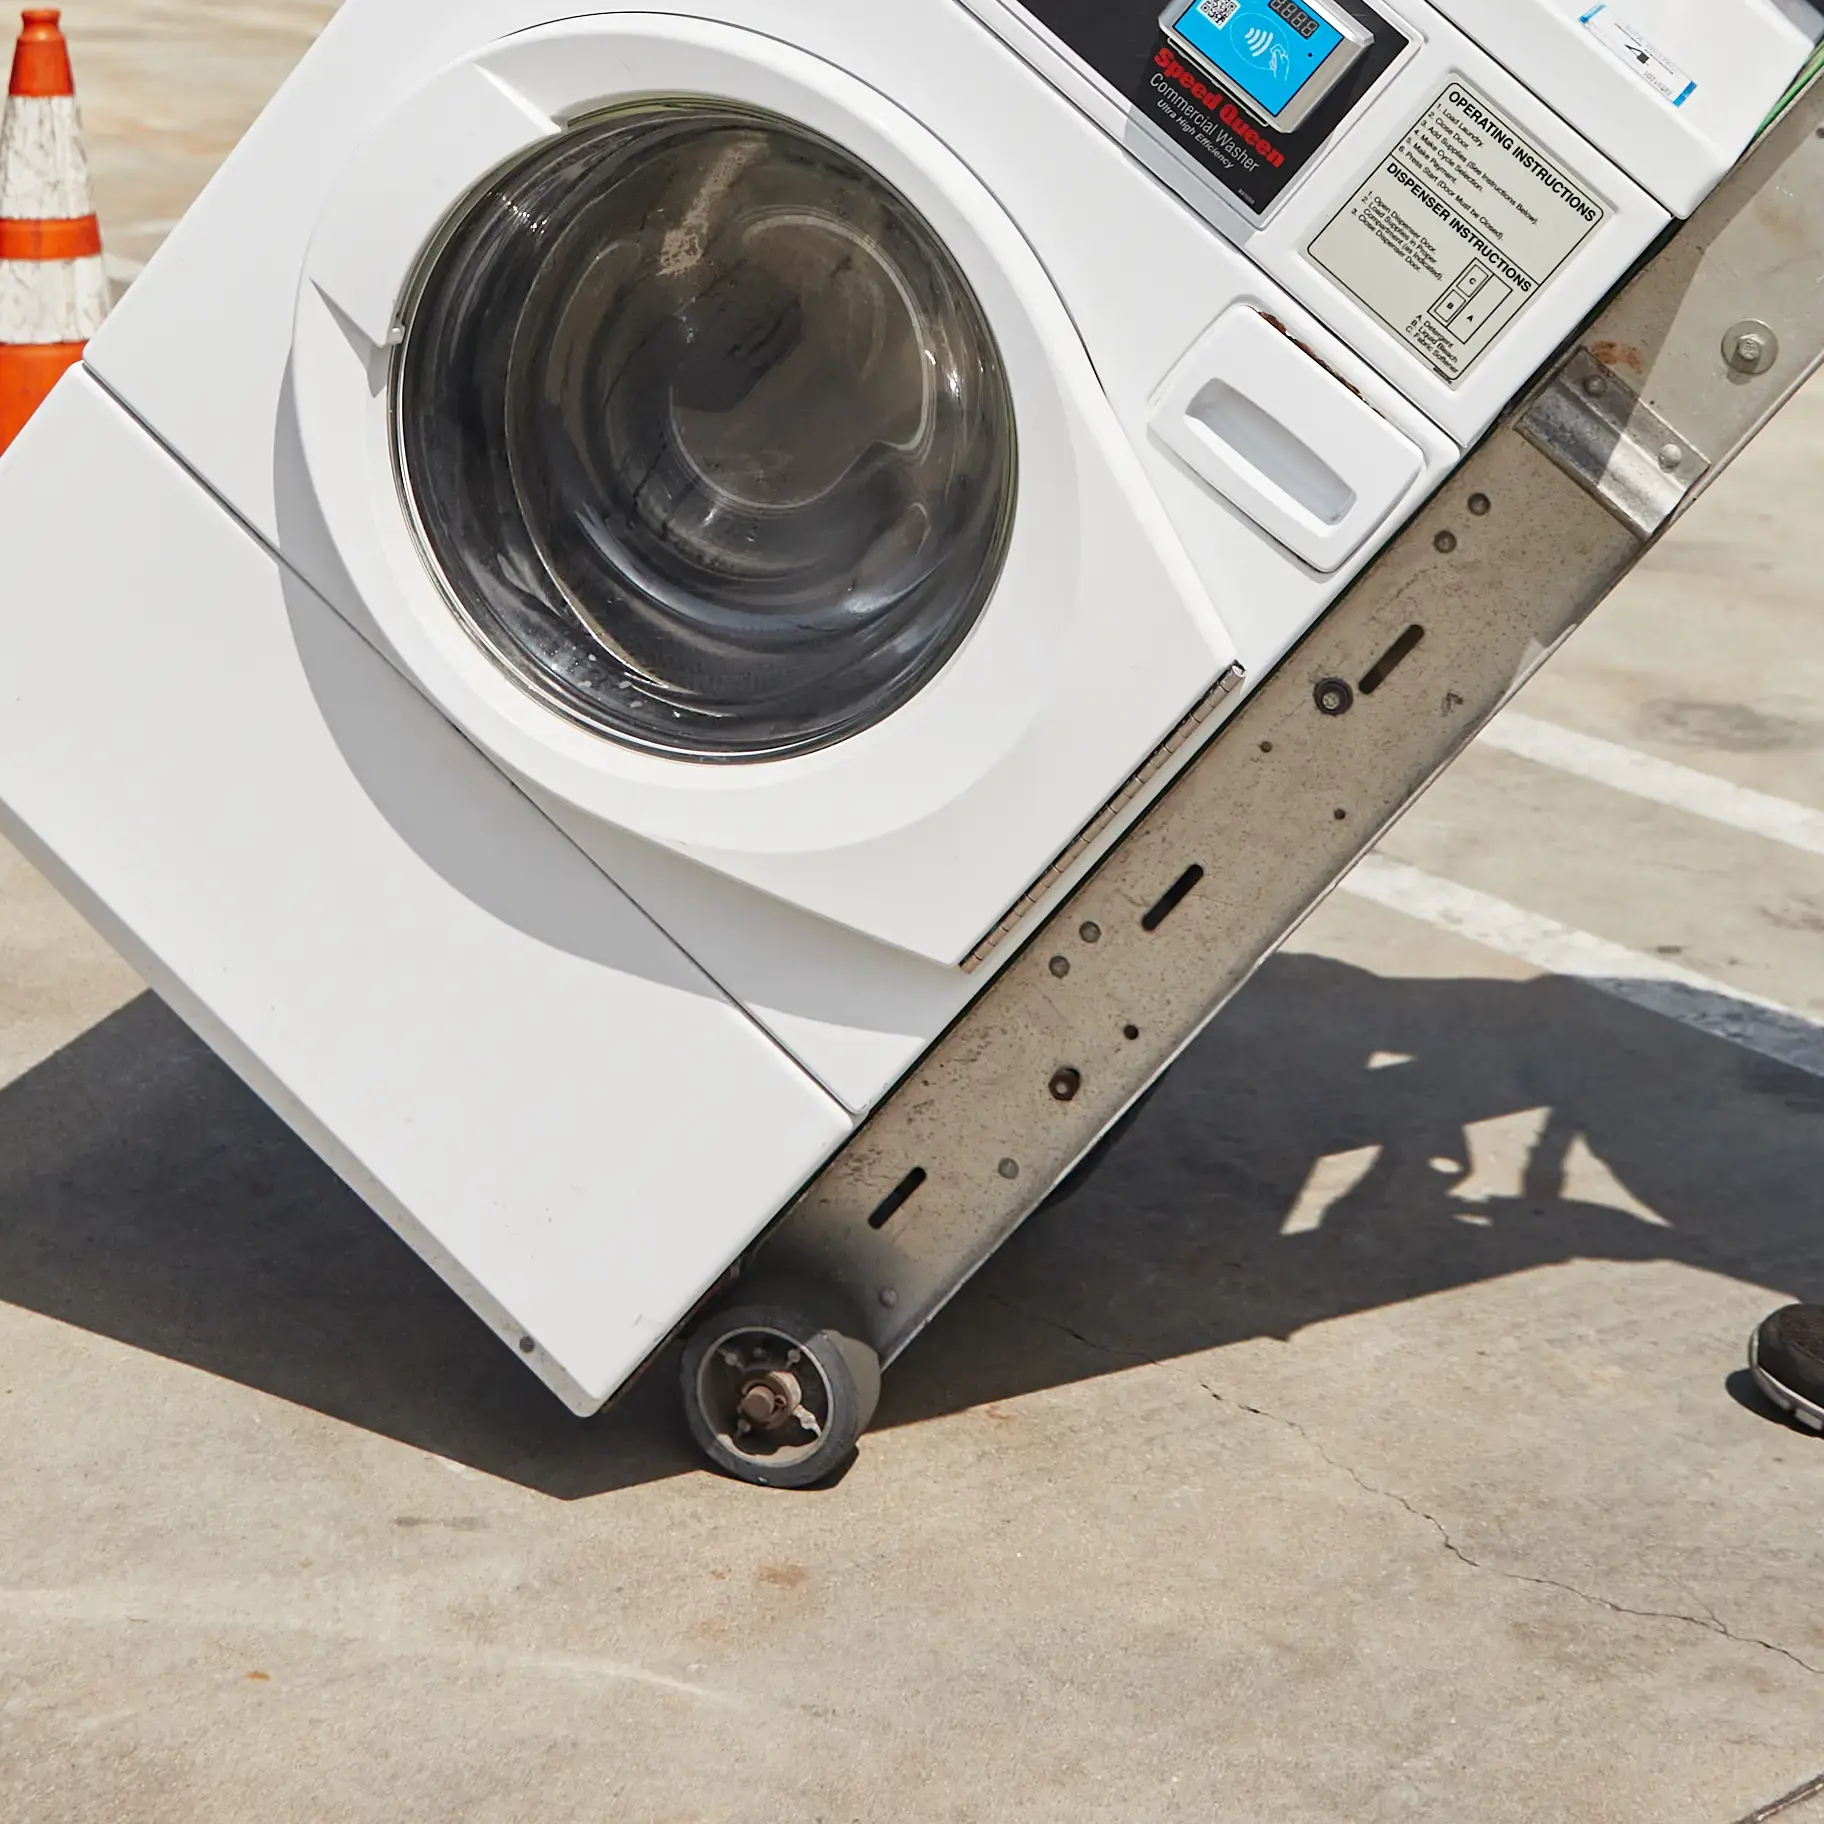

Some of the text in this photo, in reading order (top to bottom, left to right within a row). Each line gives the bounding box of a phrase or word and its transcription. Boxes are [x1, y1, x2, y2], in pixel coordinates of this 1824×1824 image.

[1149, 72, 1260, 172] Commercial Washer
[1151, 47, 1287, 167] Speed Queen
[1156, 99, 1234, 170] Ultra High Efficiency
[1435, 117, 1454, 135] Close
[1452, 133, 1470, 149] Door.
[1442, 108, 1459, 124] Load
[1457, 123, 1485, 149] Laundry.
[1405, 151, 1423, 169] Press
[1422, 167, 1438, 181] Start
[1436, 180, 1455, 197] (Door
[1454, 195, 1471, 210] Must
[1470, 209, 1479, 218] be
[1406, 137, 1458, 185] 5. Make Payment.
[1413, 128, 1484, 192] 4. Make Cycle Selection.
[1427, 126, 1442, 139] Add
[1439, 137, 1467, 163] Supplies
[1466, 161, 1482, 176] (See
[1481, 174, 1516, 206] Instructions
[1448, 90, 1595, 222] OPERATING INSTRUCTIONS
[1351, 208, 1422, 273] 3. Close Dispenser Door.
[1362, 208, 1403, 245] Compartment
[1401, 243, 1414, 255] (as
[1368, 202, 1385, 218] Load
[1383, 217, 1410, 241] Supplies
[1409, 238, 1416, 246] in
[1415, 245, 1436, 265] Proper
[1372, 197, 1391, 214] Open
[1389, 212, 1420, 240] Dispenser
[1419, 238, 1437, 254] Door.
[1386, 163, 1531, 292] DISPENSER INSTRUCTIONS
[1468, 277, 1476, 285] C
[1411, 320, 1458, 363] B. Liquid Bleach
[1415, 314, 1453, 349] A. Detergent
[1466, 314, 1474, 322] A
[1405, 325, 1458, 374] C. Fabric Softener
